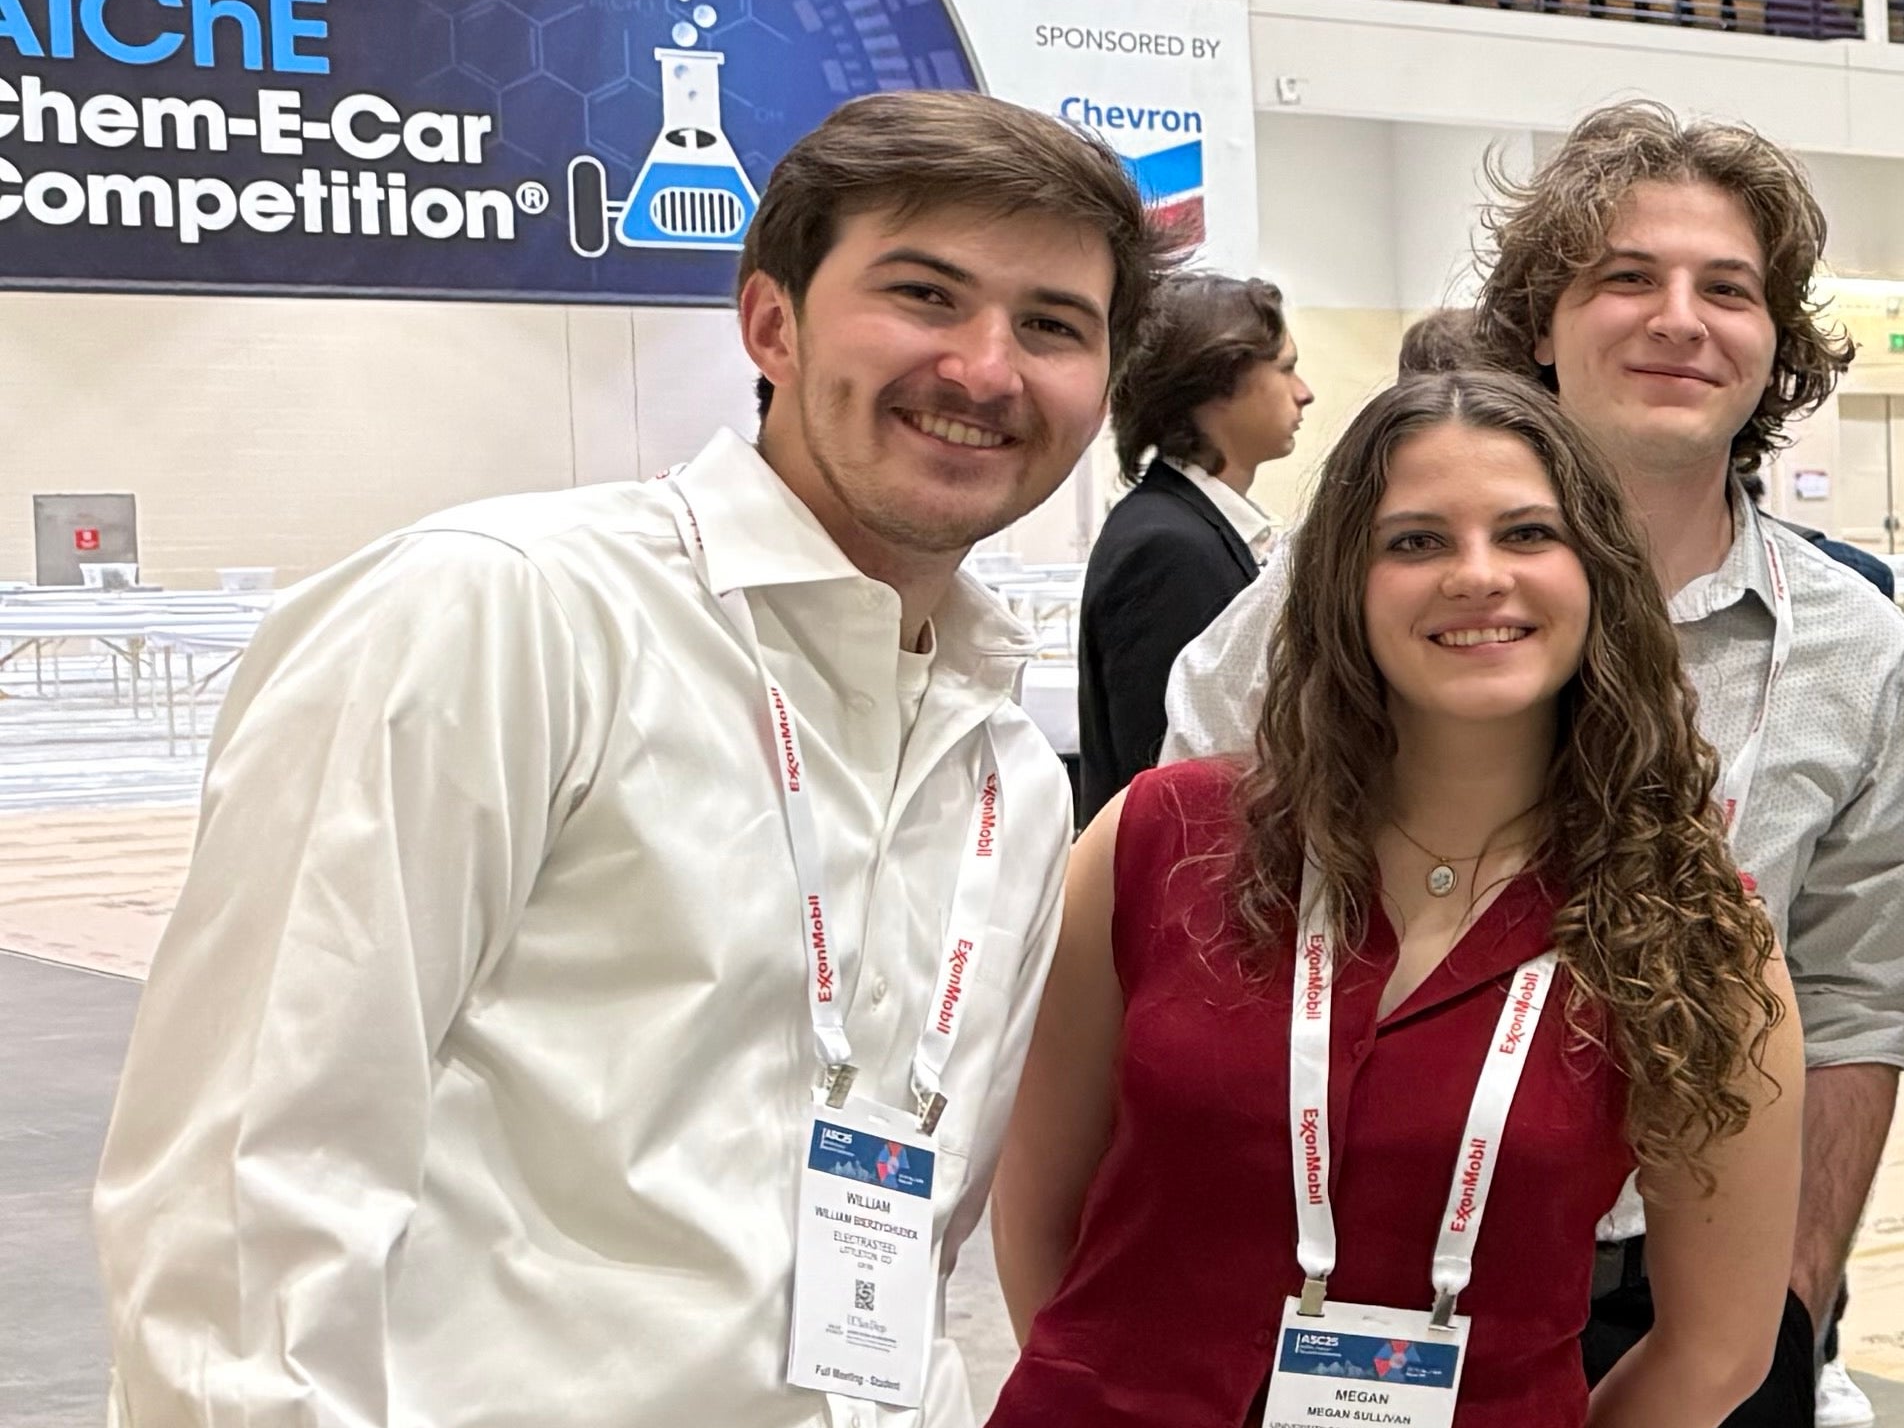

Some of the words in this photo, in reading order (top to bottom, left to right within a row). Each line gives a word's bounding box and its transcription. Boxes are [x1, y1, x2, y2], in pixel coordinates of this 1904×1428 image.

[1035, 24, 1185, 57] SPONSORED
[1191, 37, 1221, 59] BY
[1060, 96, 1203, 134] Chevron
[809, 895, 832, 1002] ExxonMobil
[938, 939, 973, 1033] ExxonMobil
[1305, 933, 1325, 1021] ExxonMobil
[1499, 972, 1539, 1055] ExxonMobil
[1299, 1108, 1323, 1205] ExxonMobil
[1450, 1137, 1487, 1234] ExxonMobil
[1307, 1406, 1350, 1419] MEGAN
[1354, 1411, 1411, 1425] SULLIVAN
[1335, 1389, 1389, 1405] MEGAN
